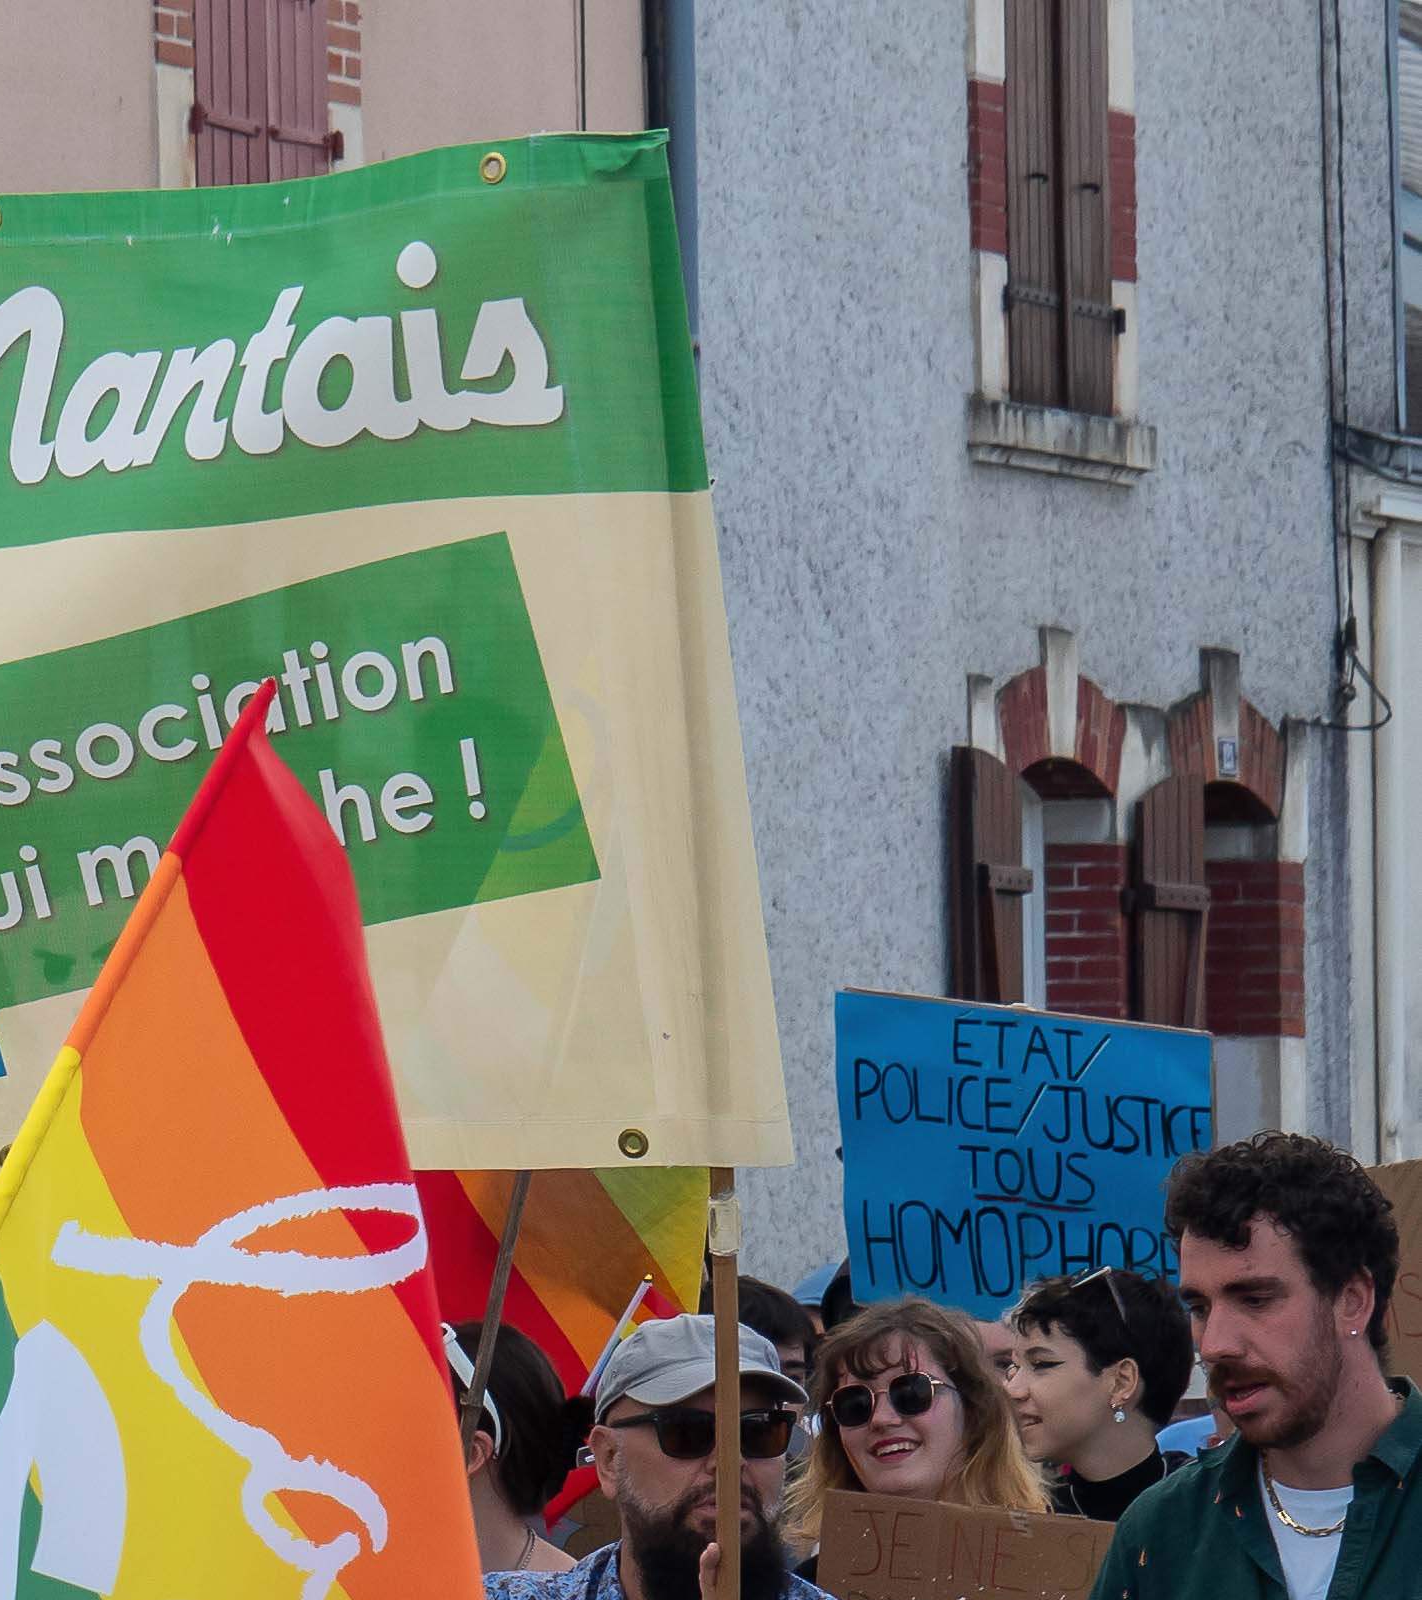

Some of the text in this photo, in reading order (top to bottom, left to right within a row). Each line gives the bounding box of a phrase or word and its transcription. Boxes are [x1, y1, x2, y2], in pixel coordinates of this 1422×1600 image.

[75, 769, 435, 908] mhe
[959, 1145, 1096, 1206] TOUS
[849, 1509, 924, 1582] JE
[949, 1520, 1028, 1593] NE
